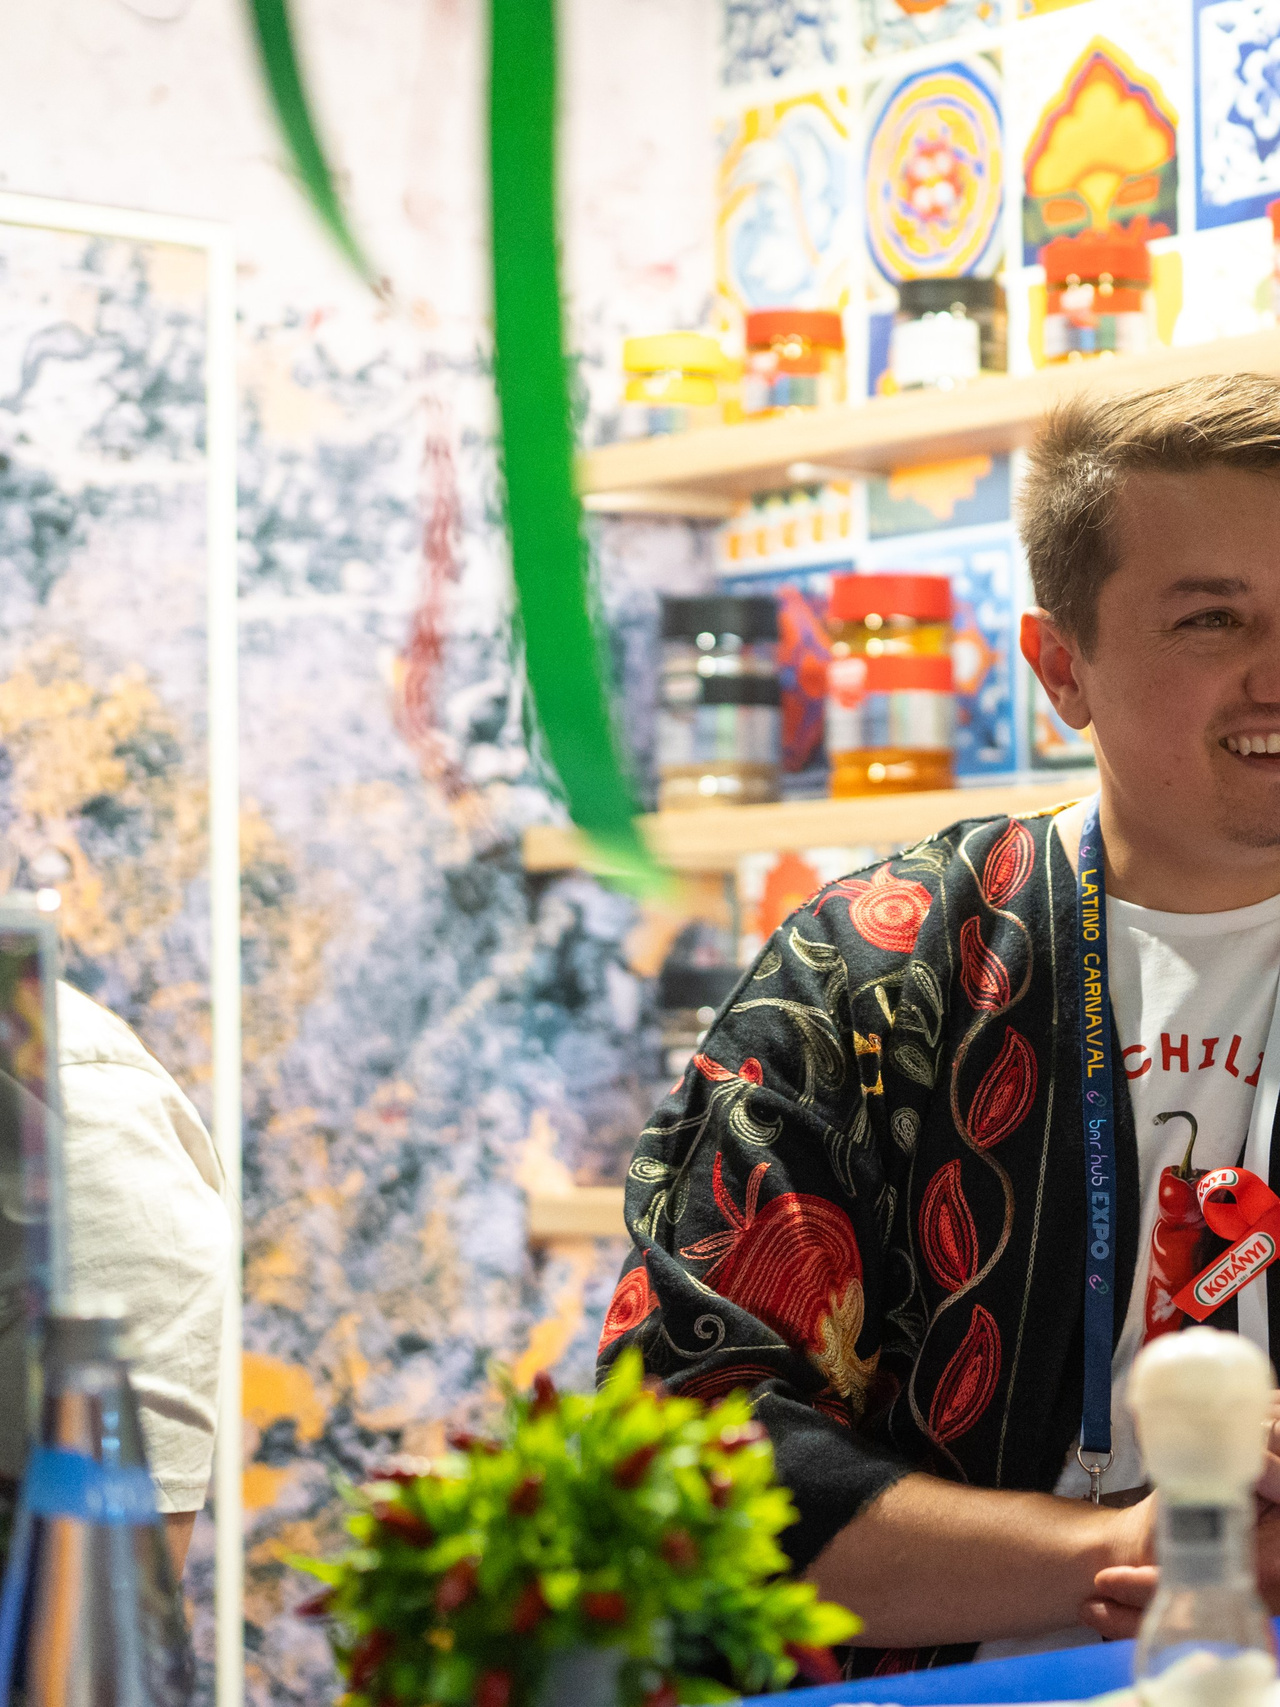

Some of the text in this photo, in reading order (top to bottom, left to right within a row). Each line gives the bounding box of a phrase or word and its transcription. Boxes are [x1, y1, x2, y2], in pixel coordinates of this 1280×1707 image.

[1081, 868, 1105, 1078] LATINO CARNAVAL
[1090, 1154, 1110, 1187] hub
[1090, 1191, 1110, 1260] EXPO
[1202, 1240, 1268, 1299] KOTÁNYI
